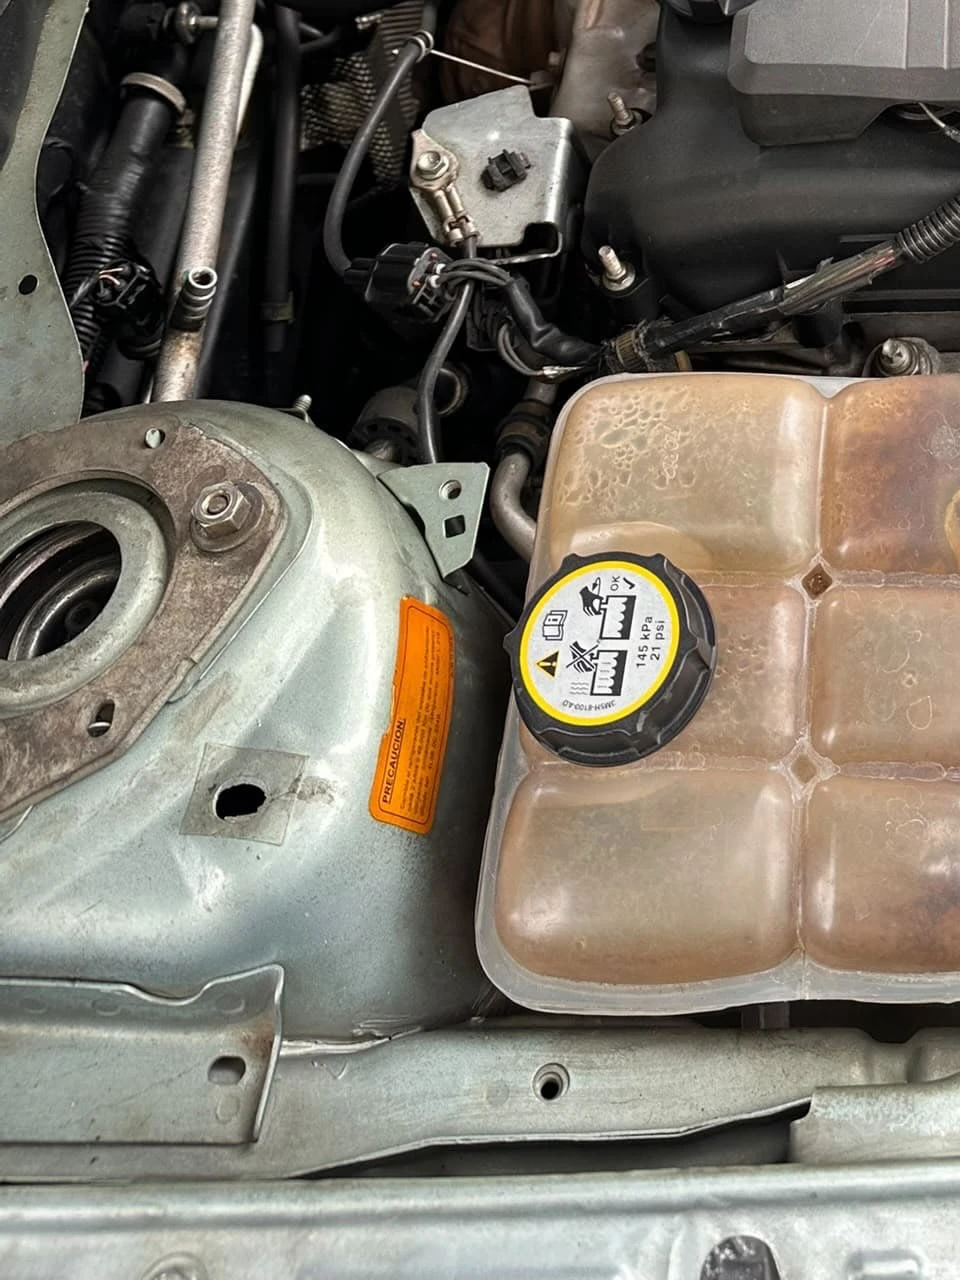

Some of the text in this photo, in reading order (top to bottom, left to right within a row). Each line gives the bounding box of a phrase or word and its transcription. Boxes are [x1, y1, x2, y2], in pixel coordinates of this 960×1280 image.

[610, 576, 621, 591] OK
[636, 616, 653, 668] 145 kPa
[650, 619, 665, 661] 21 psi
